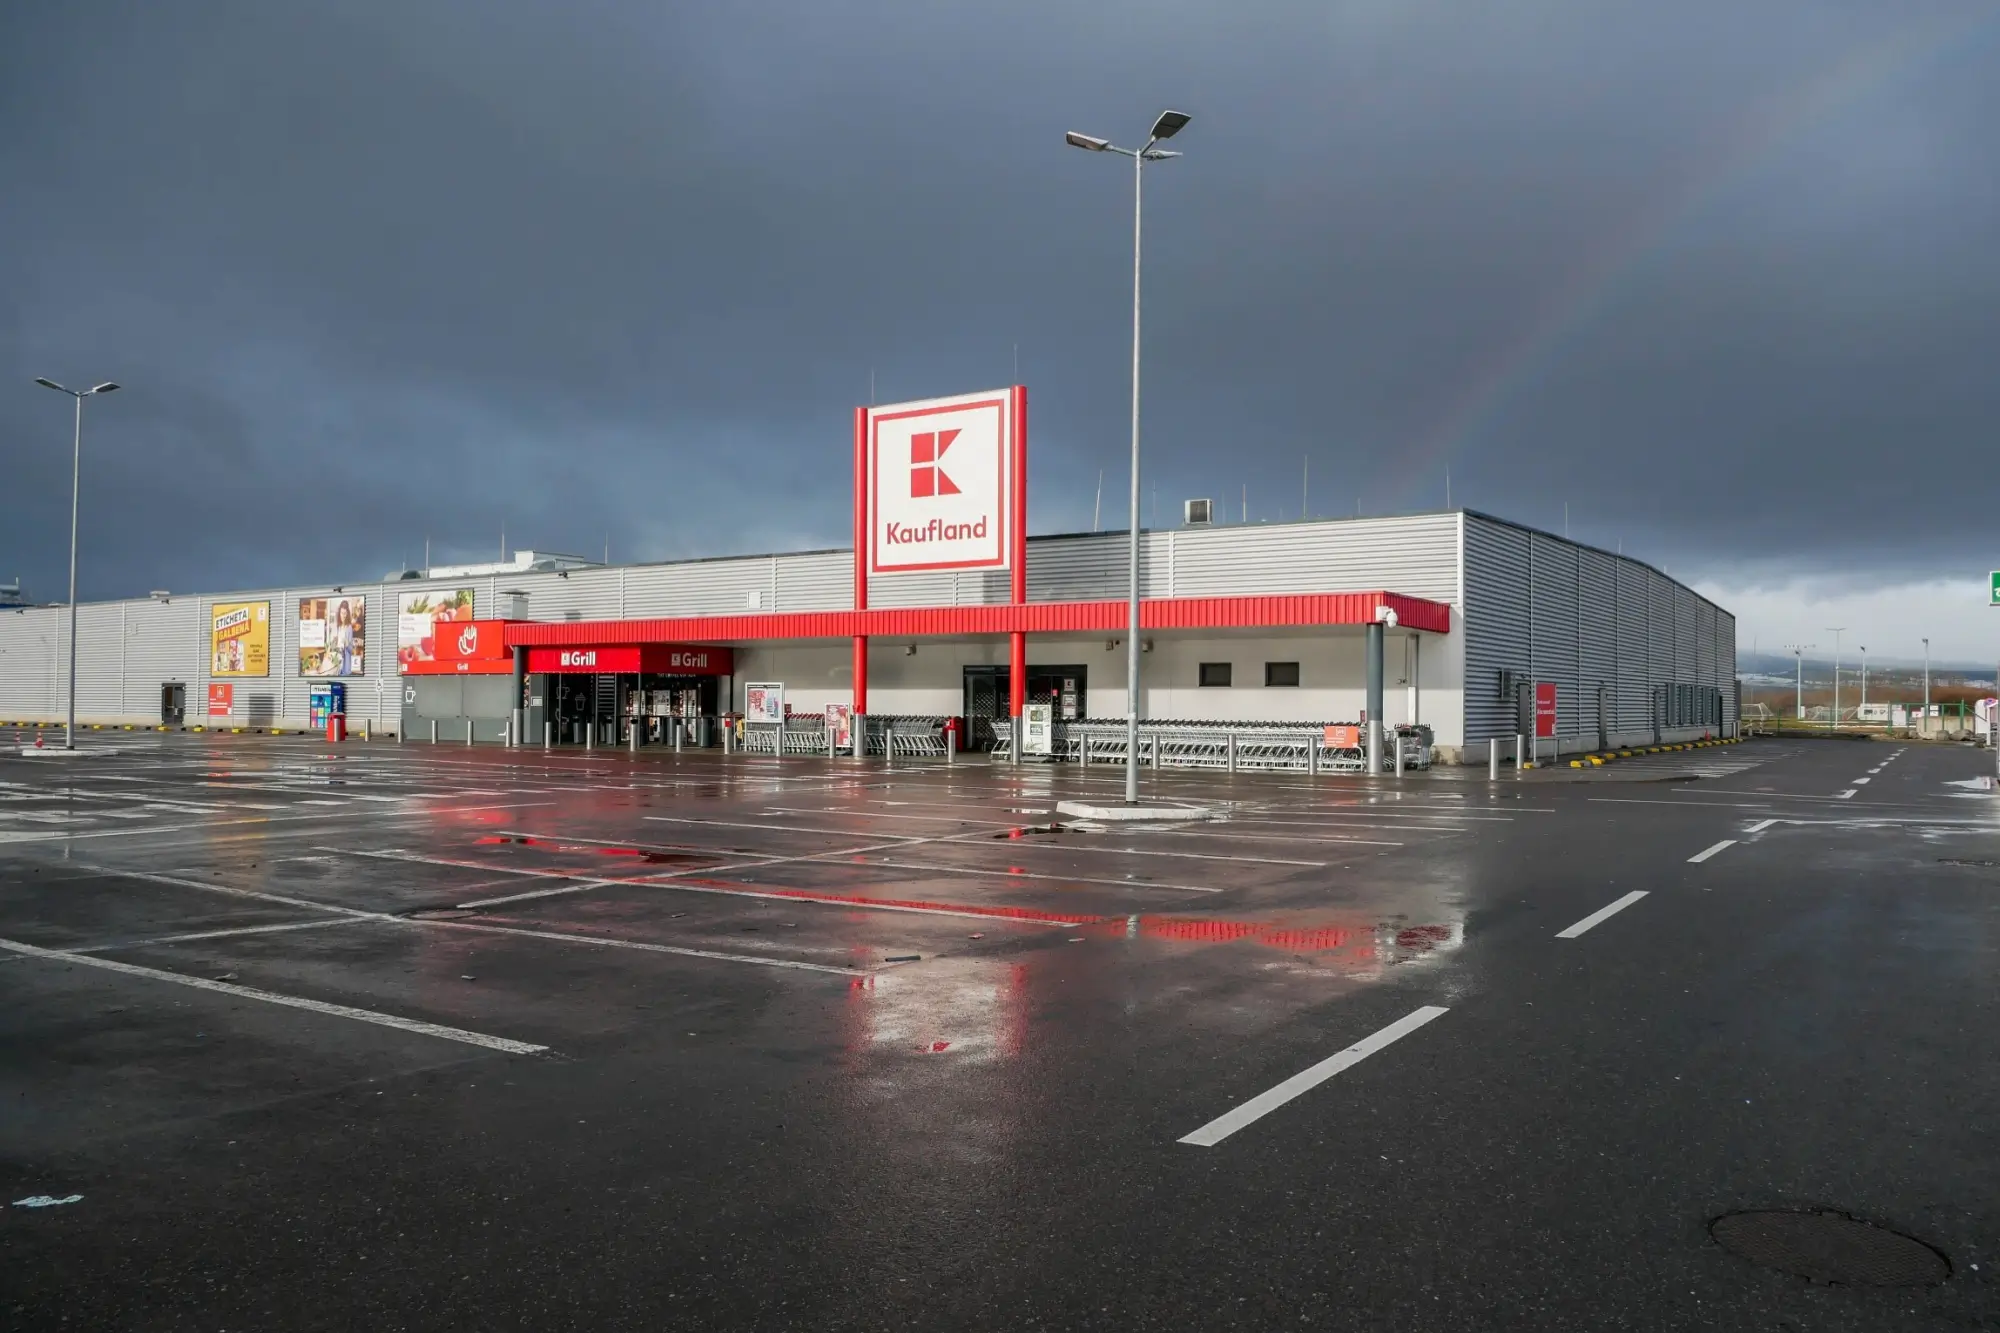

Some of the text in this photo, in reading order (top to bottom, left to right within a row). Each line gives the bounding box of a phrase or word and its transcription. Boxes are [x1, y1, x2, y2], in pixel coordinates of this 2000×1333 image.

[887, 515, 987, 545] Kaufland
[216, 609, 248, 629] ETICHETA
[571, 651, 596, 666] Grill
[682, 652, 707, 668] Grill
[457, 663, 469, 671] Grill
